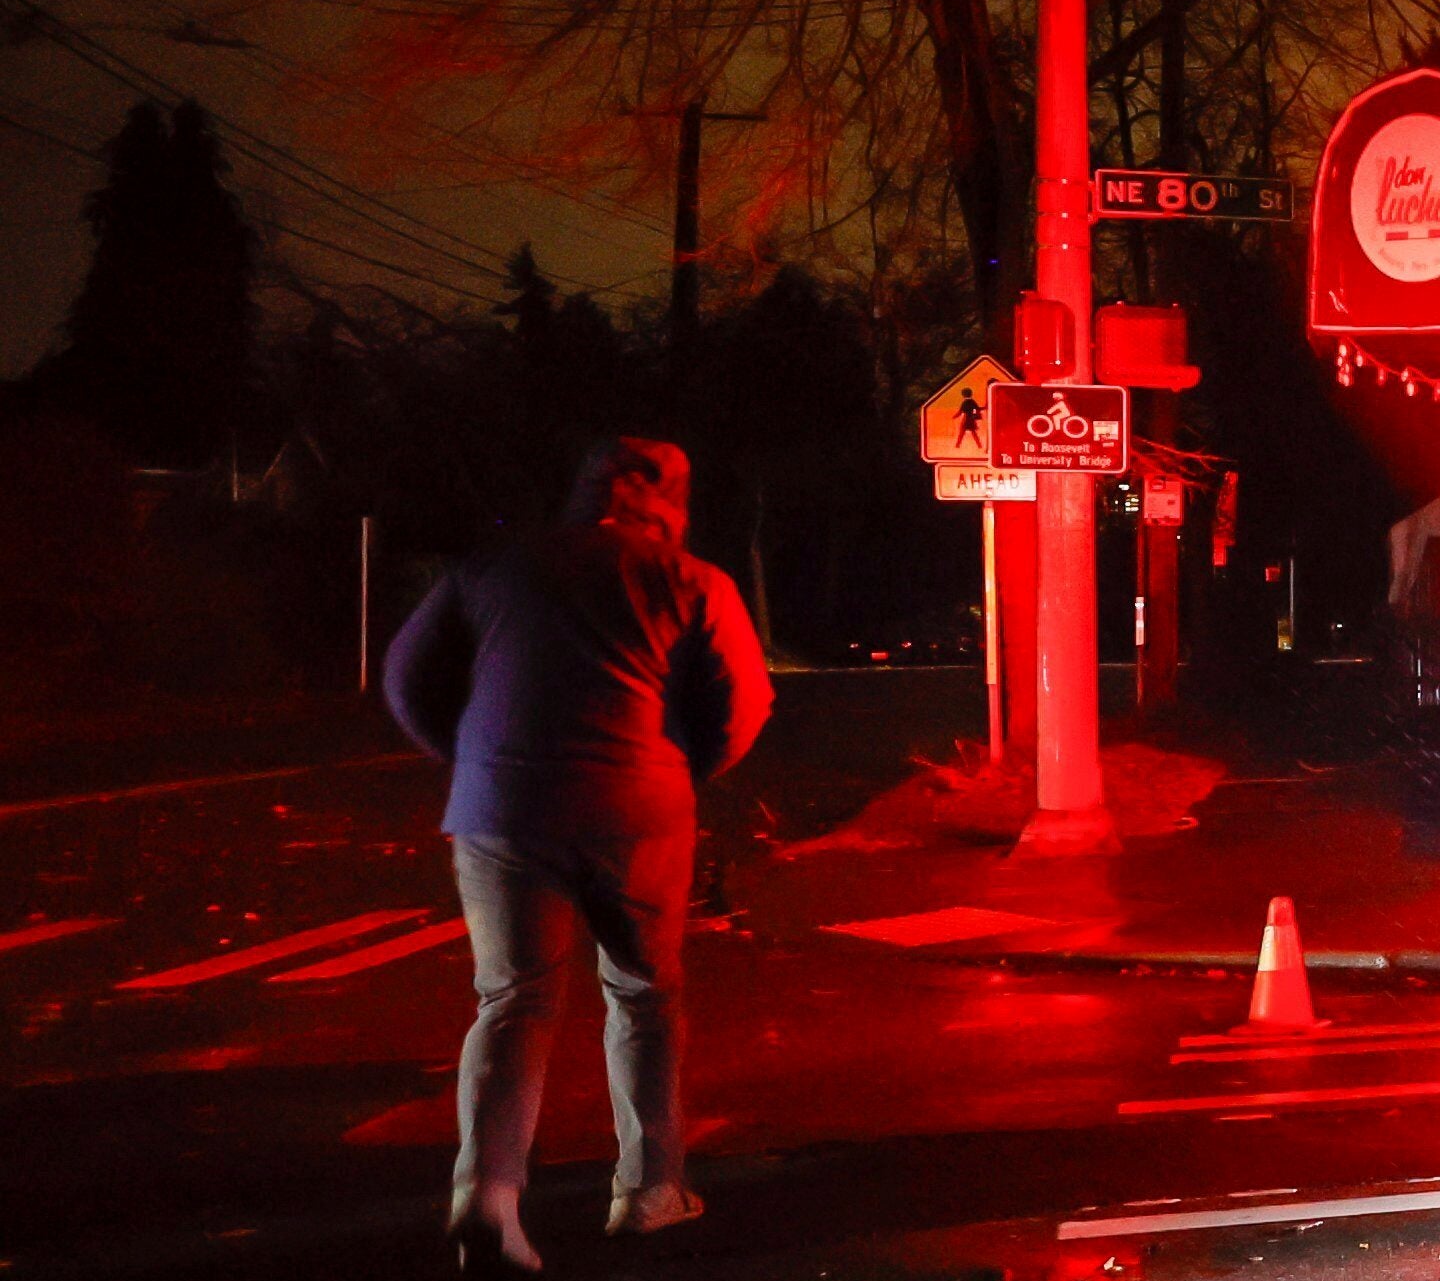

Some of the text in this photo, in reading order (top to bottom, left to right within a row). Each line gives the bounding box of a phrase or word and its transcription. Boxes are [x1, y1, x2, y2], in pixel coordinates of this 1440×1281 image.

[1107, 178, 1283, 212] NE 80th St
[1023, 441, 1091, 453] To Roosevelt
[1001, 453, 1112, 468] To University Bridge
[957, 473, 1020, 490] AHEAD
